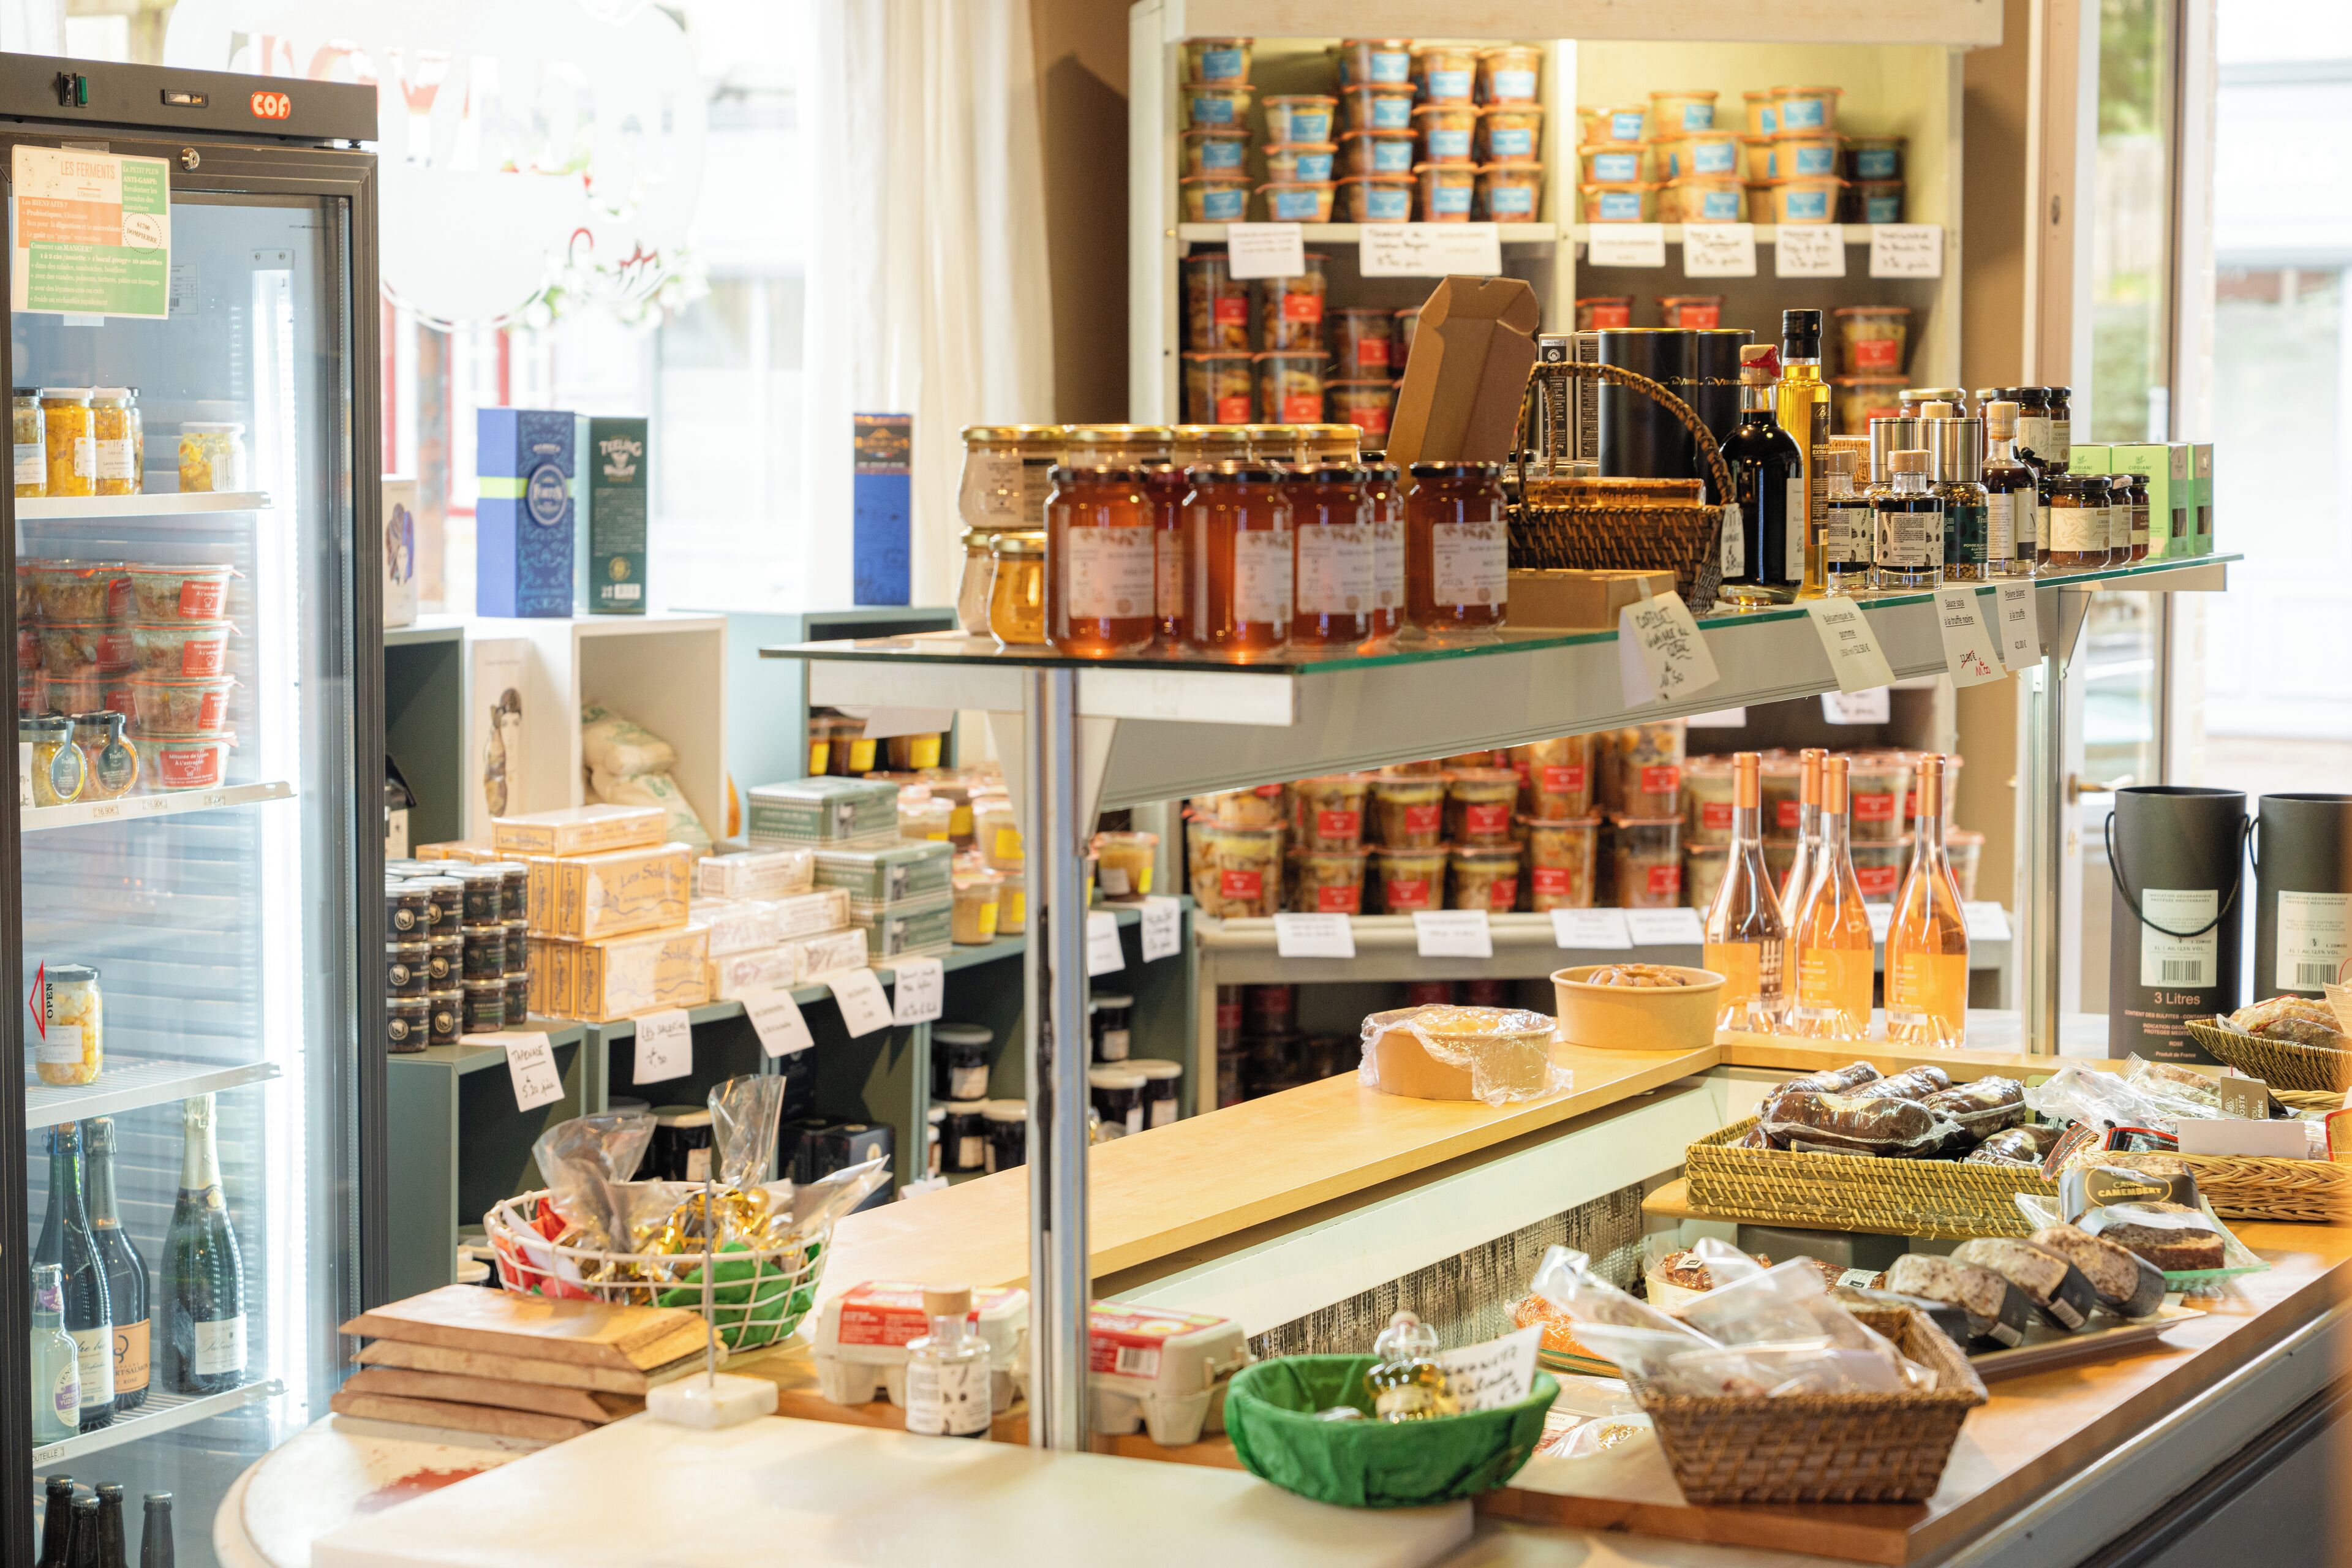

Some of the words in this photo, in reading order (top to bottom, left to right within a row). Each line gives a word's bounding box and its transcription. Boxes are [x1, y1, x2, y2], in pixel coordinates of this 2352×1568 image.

[61, 160, 74, 176] LES
[77, 162, 115, 179] FERMENTS
[32, 199, 63, 208] BIENFAITS
[27, 209, 63, 219] Probiotiques,
[56, 221, 81, 230] digestion
[92, 224, 122, 232] microbiote
[137, 222, 150, 231] 61700
[127, 228, 157, 244] DOMPIERRE
[2005, 590, 2016, 599] Poivre
[1945, 599, 1956, 608] Sauce
[1956, 598, 1965, 607] soja
[2016, 609, 2026, 618] truffe
[1951, 616, 1962, 624] truffe
[1962, 614, 1974, 623] noire
[2155, 992, 2162, 1004] 3
[2166, 992, 2201, 1005] Litres
[2097, 1187, 2162, 1197] CAMEMBERT
[115, 1363, 148, 1376] RT-SALMON
[32, 1449, 58, 1463] OUTEILLE
